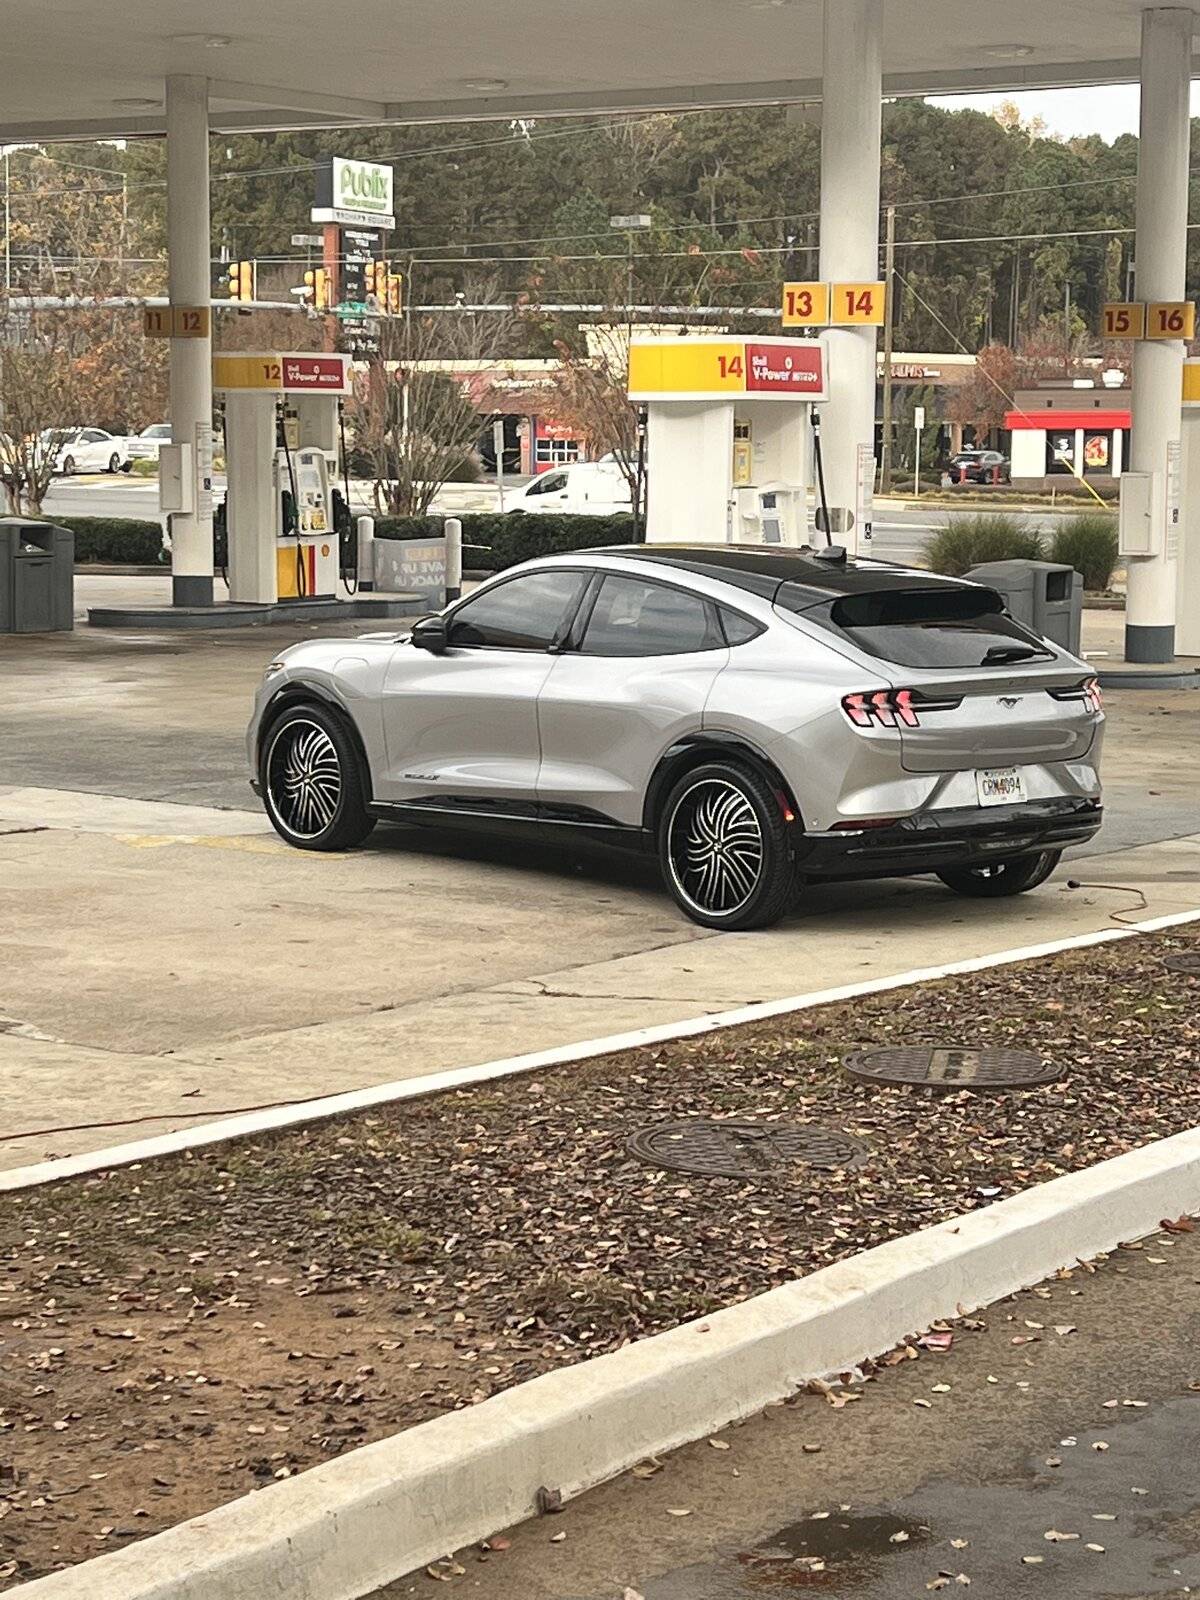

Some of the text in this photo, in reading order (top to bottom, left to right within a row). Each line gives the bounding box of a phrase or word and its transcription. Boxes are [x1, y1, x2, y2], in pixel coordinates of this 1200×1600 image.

[341, 164, 389, 199] Publix
[786, 291, 812, 317] 13
[846, 291, 873, 316] 14
[147, 312, 162, 331] 11
[182, 312, 202, 331] 12
[1105, 310, 1129, 332] 15
[1159, 310, 1184, 331] 16
[263, 364, 281, 380] 12
[718, 356, 743, 378] 14
[753, 367, 791, 381] V-Power
